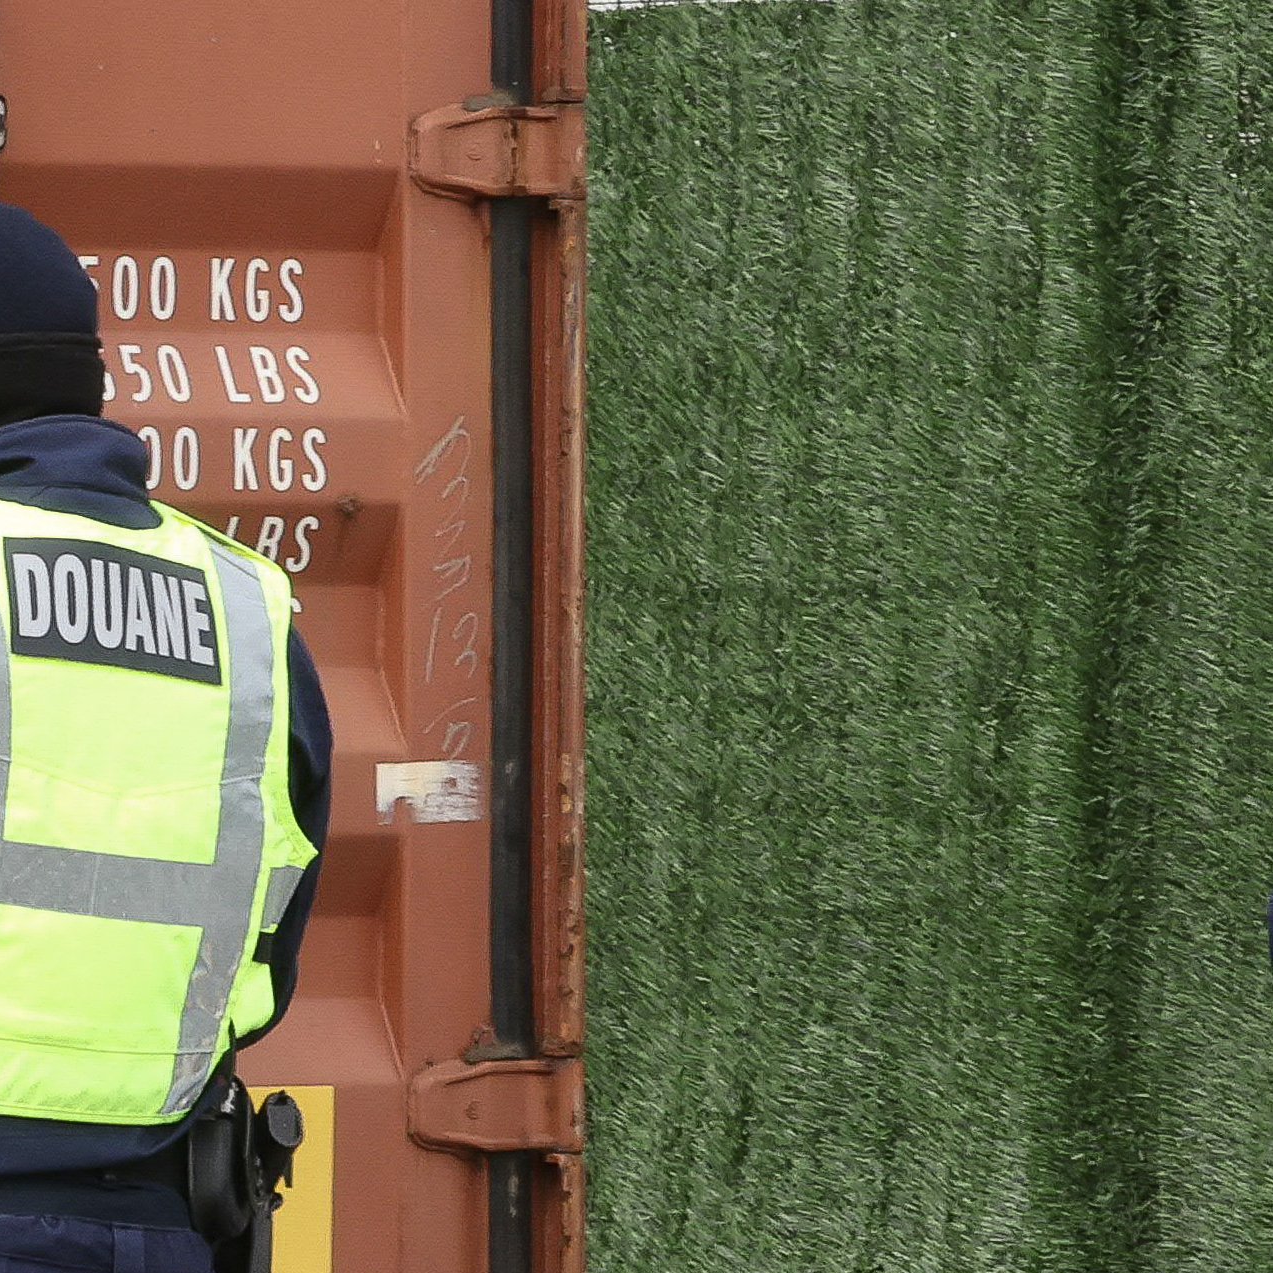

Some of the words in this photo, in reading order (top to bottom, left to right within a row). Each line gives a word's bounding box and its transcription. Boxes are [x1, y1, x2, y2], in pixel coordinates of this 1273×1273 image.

[210, 257, 304, 322] KGS
[214, 345, 320, 404] LBS
[232, 427, 327, 491] KGS
[12, 553, 215, 666] DOUANE
